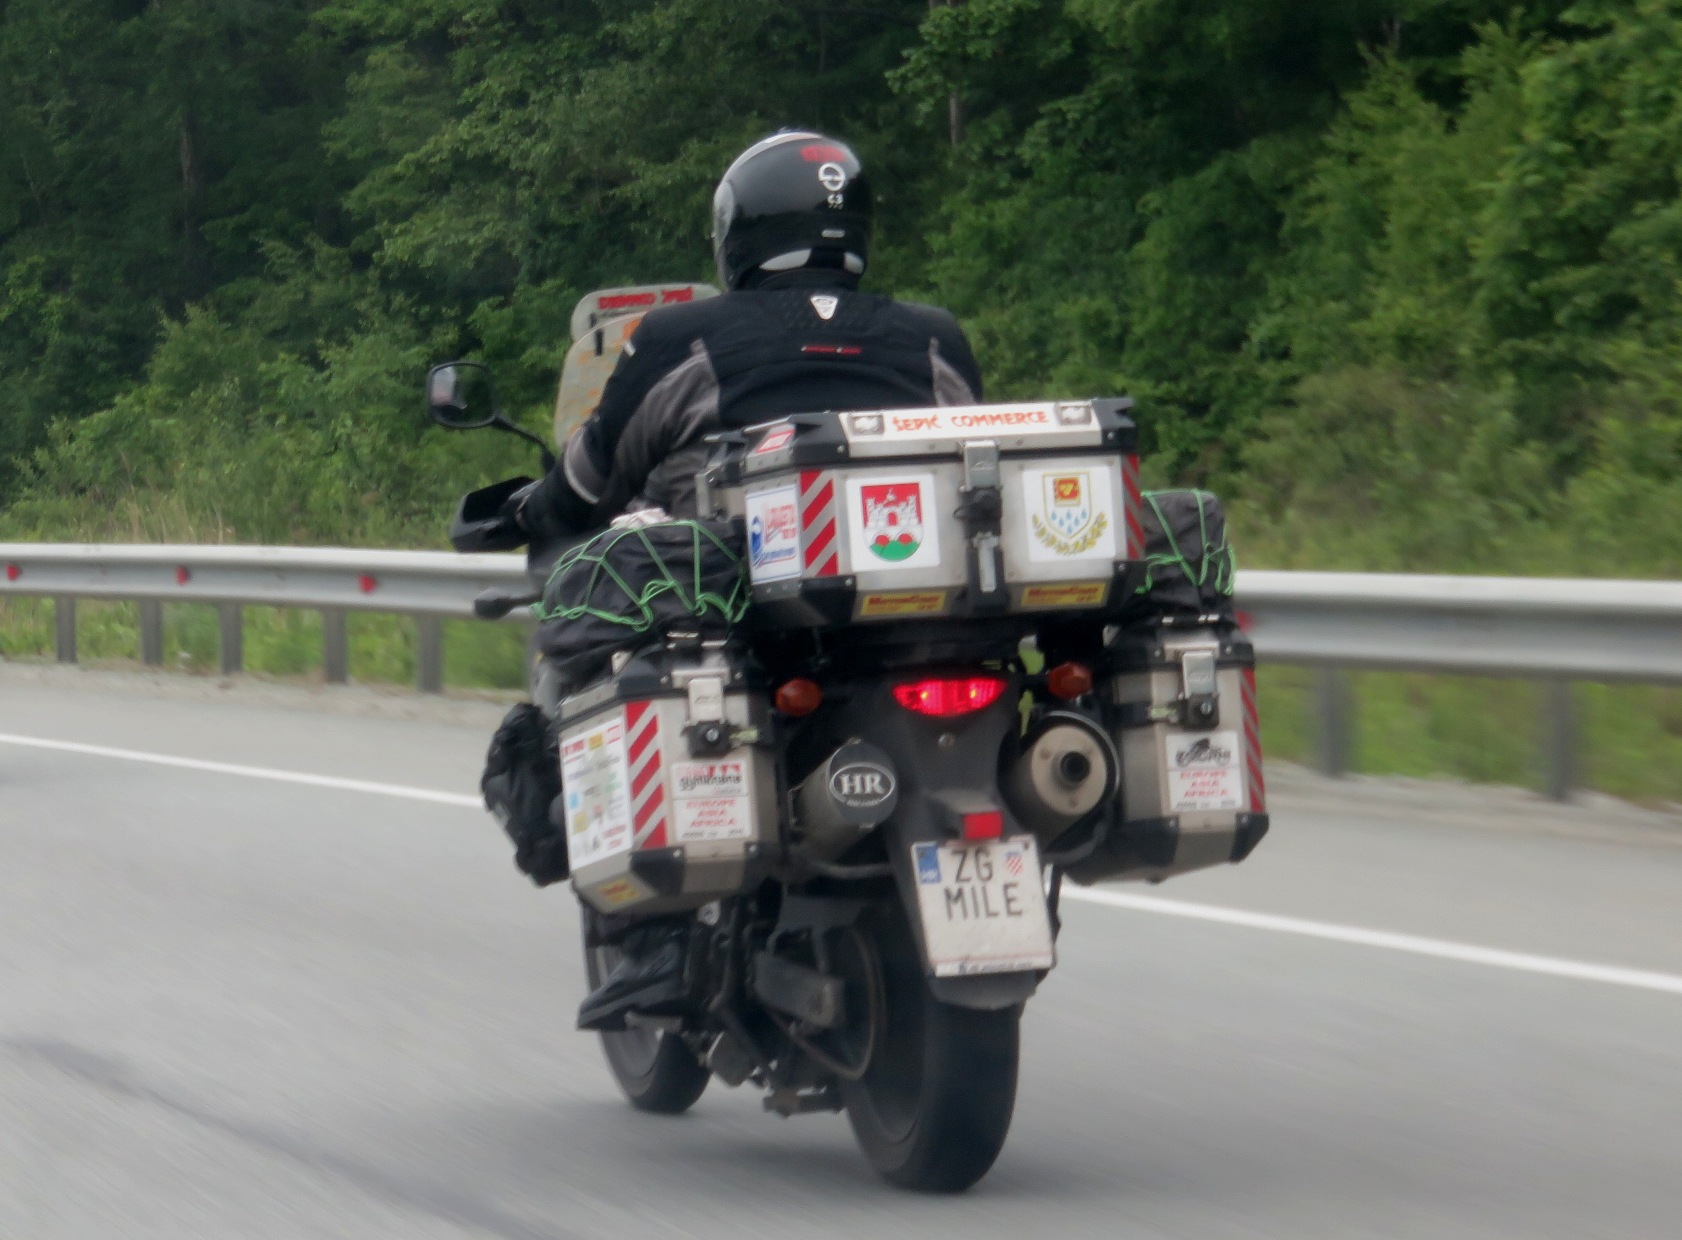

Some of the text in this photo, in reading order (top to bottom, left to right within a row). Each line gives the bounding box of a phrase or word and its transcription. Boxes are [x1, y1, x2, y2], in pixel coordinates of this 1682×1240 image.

[951, 411, 1048, 427] COMMERCE
[840, 773, 885, 795] HR
[951, 847, 993, 883] ZG
[944, 882, 1023, 921] MILE
